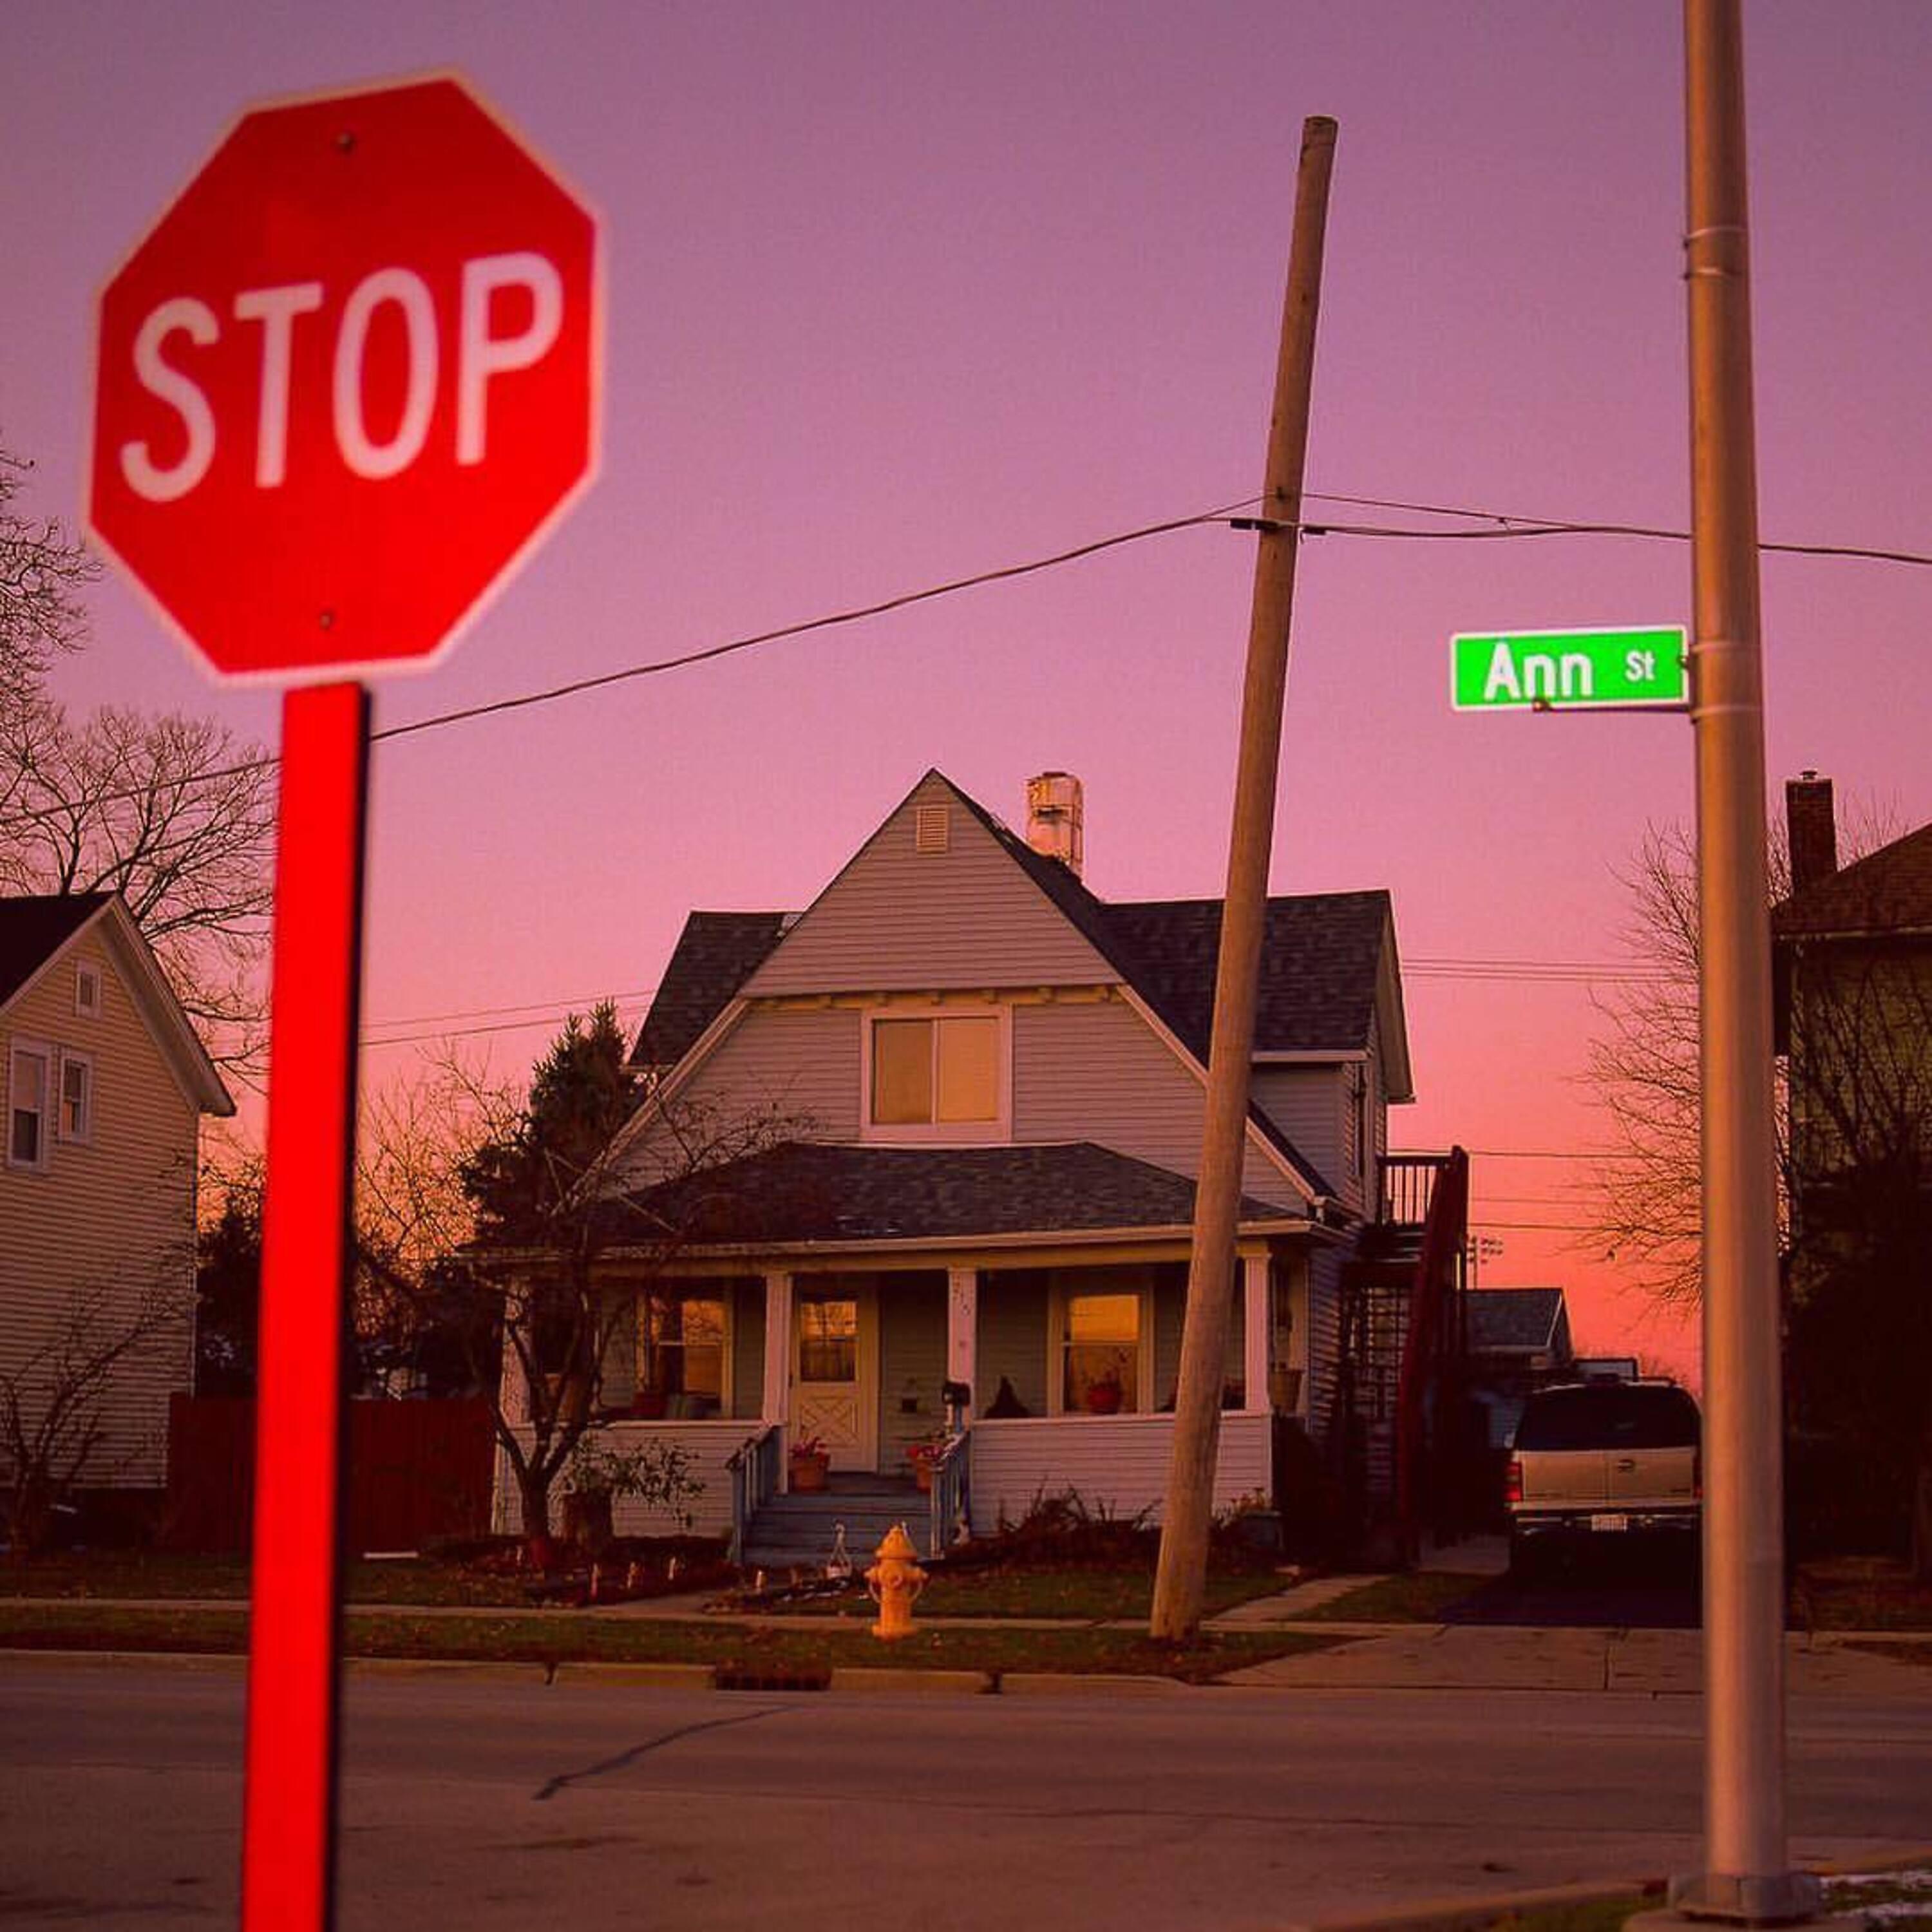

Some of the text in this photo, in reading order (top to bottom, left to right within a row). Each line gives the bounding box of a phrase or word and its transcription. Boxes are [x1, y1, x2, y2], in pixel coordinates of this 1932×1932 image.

[120, 252, 564, 502] STOP
[1484, 642, 1655, 700] Ann St
